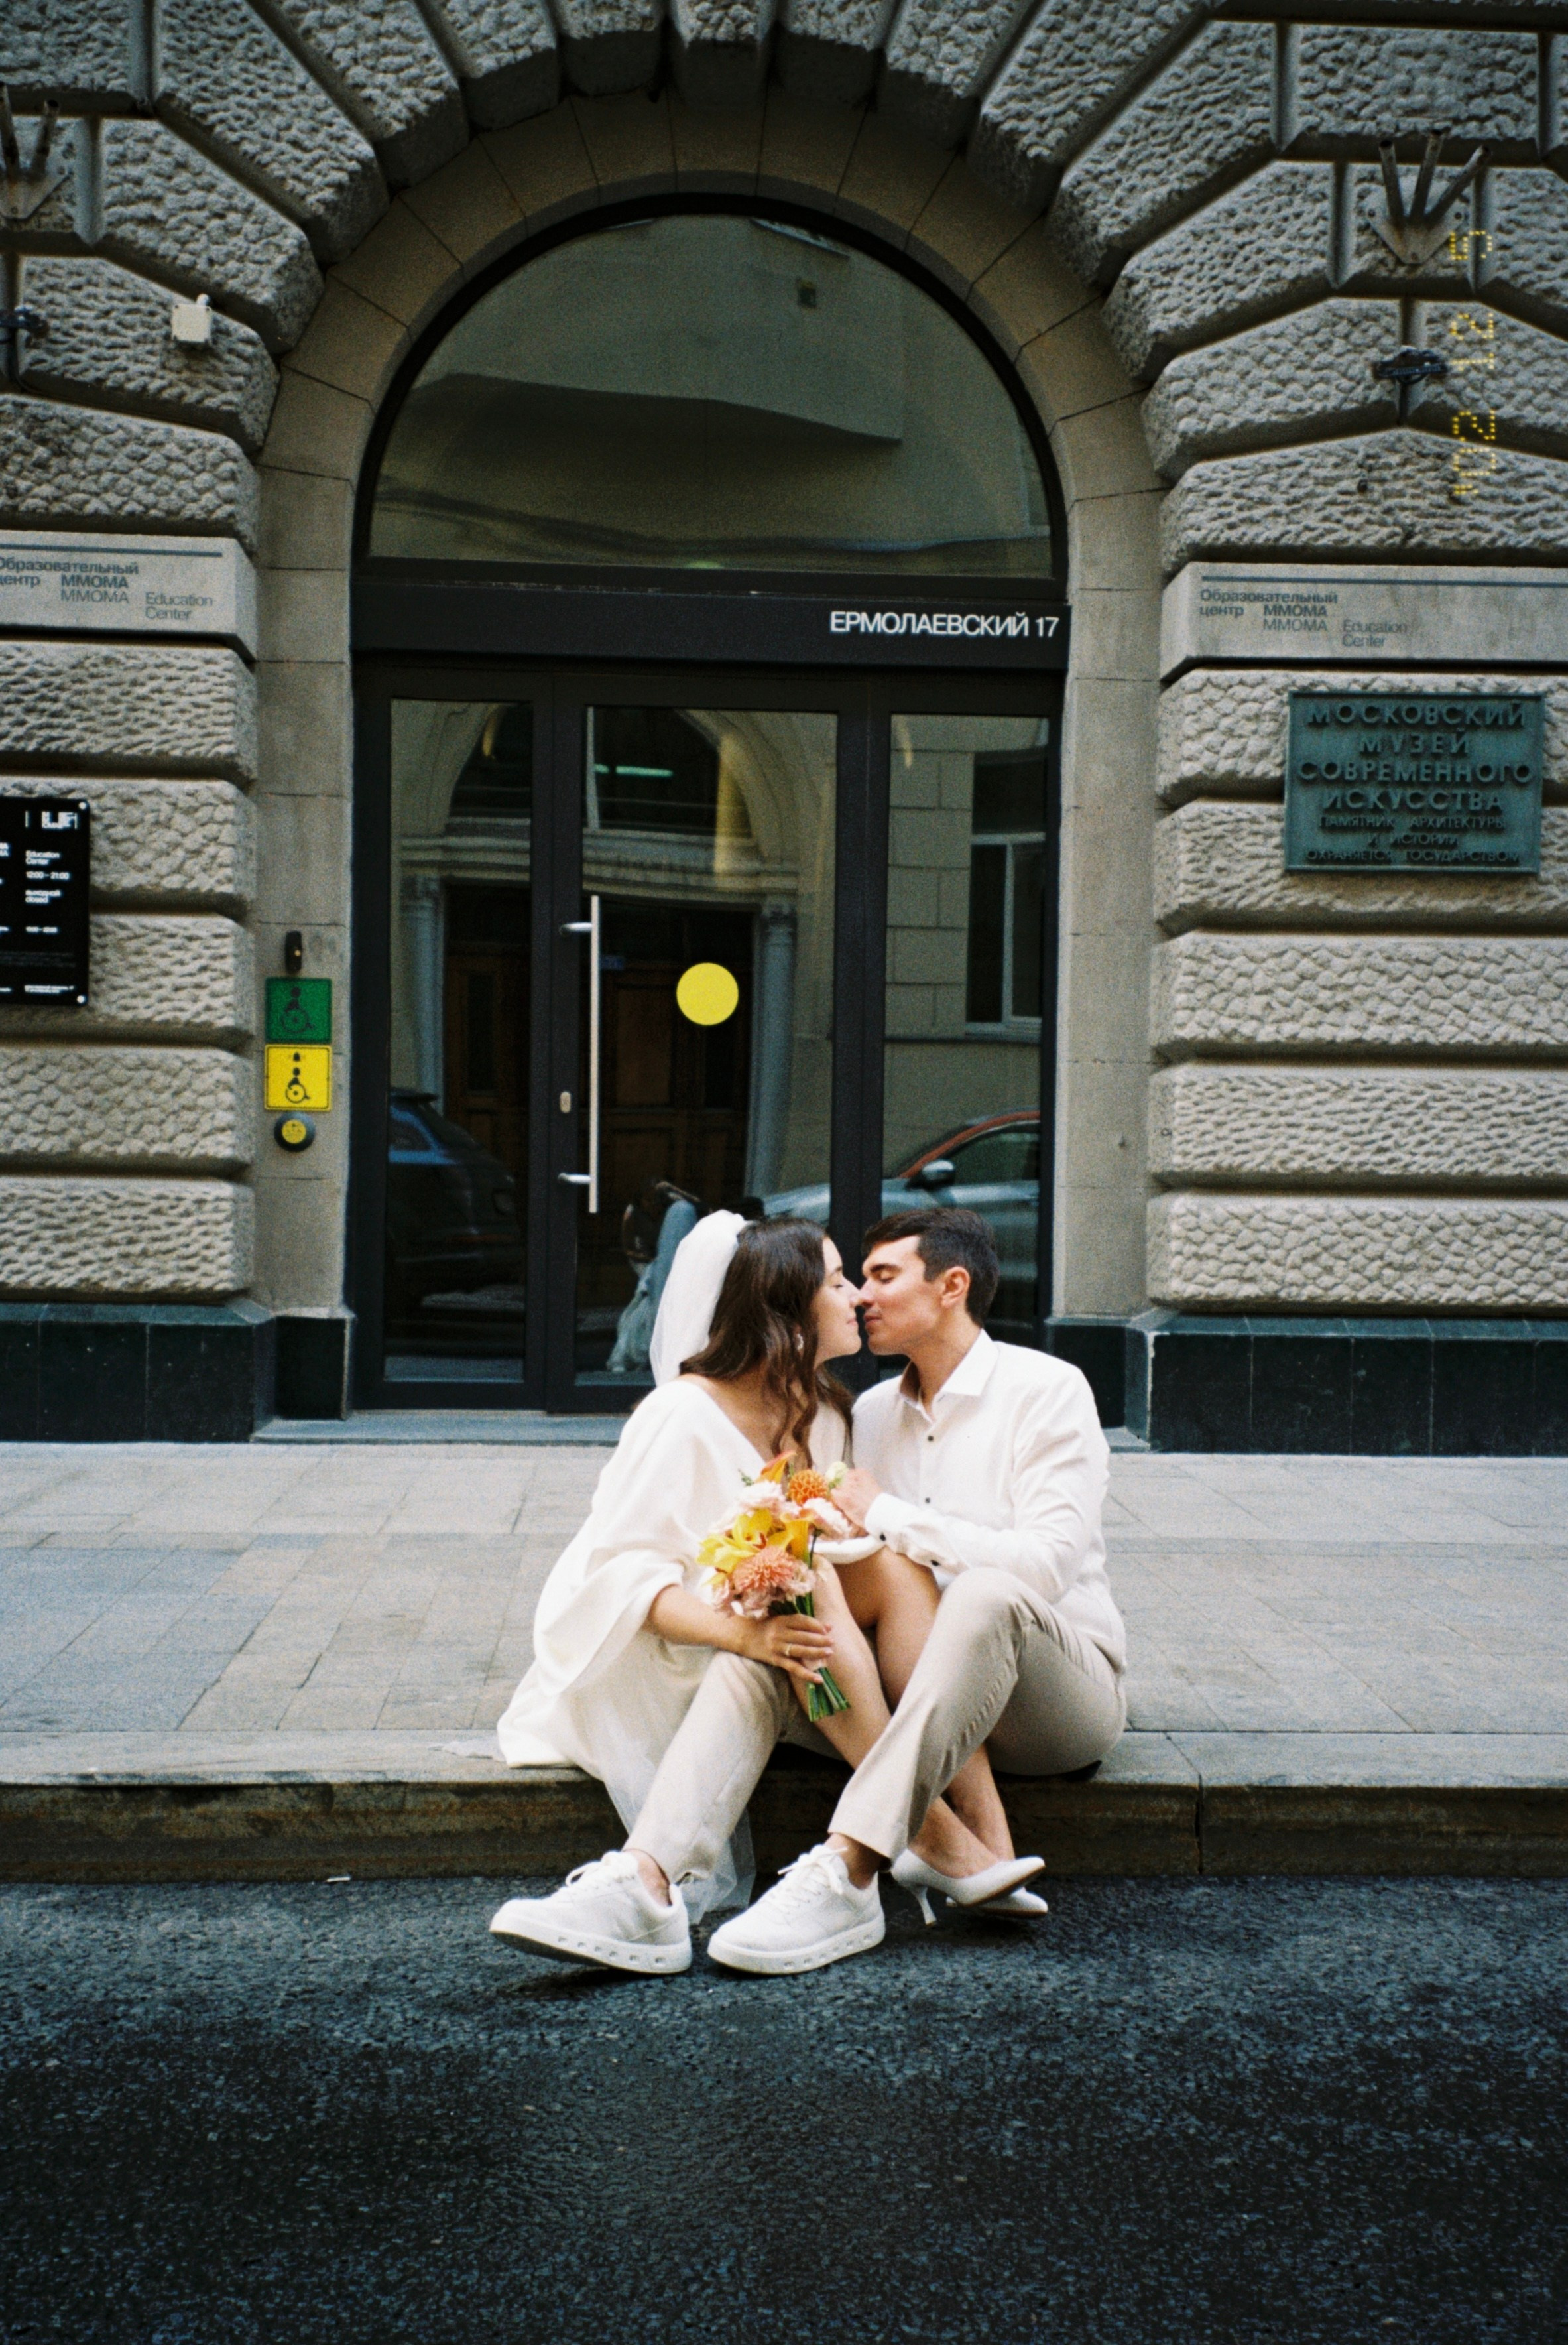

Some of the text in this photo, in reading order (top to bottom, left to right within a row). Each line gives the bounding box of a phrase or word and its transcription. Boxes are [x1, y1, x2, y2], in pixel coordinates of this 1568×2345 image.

[146, 592, 213, 605] Education
[1200, 589, 1337, 603] Образовательный
[145, 606, 191, 620] Center
[1199, 606, 1244, 618] центр
[830, 611, 1059, 637] ЕРМОЛАЕВСКИЙ 17
[1343, 619, 1407, 633] Education
[1343, 634, 1386, 647] Center
[1308, 699, 1526, 727] МОСКОВСКИЙ
[1359, 728, 1470, 755] МУЗЕЙ
[1298, 761, 1533, 783] СОВРЕМЕННОГО
[1323, 791, 1503, 812] ИСКУССТВА
[1320, 816, 1506, 829] ПАМЯТНИК АРХИТЕКТУРЫ
[1391, 834, 1458, 846] ИСТОРИИ
[1306, 850, 1520, 862] ОХРАНЯЕТСЯ ГОСУДАРСТВОМ
